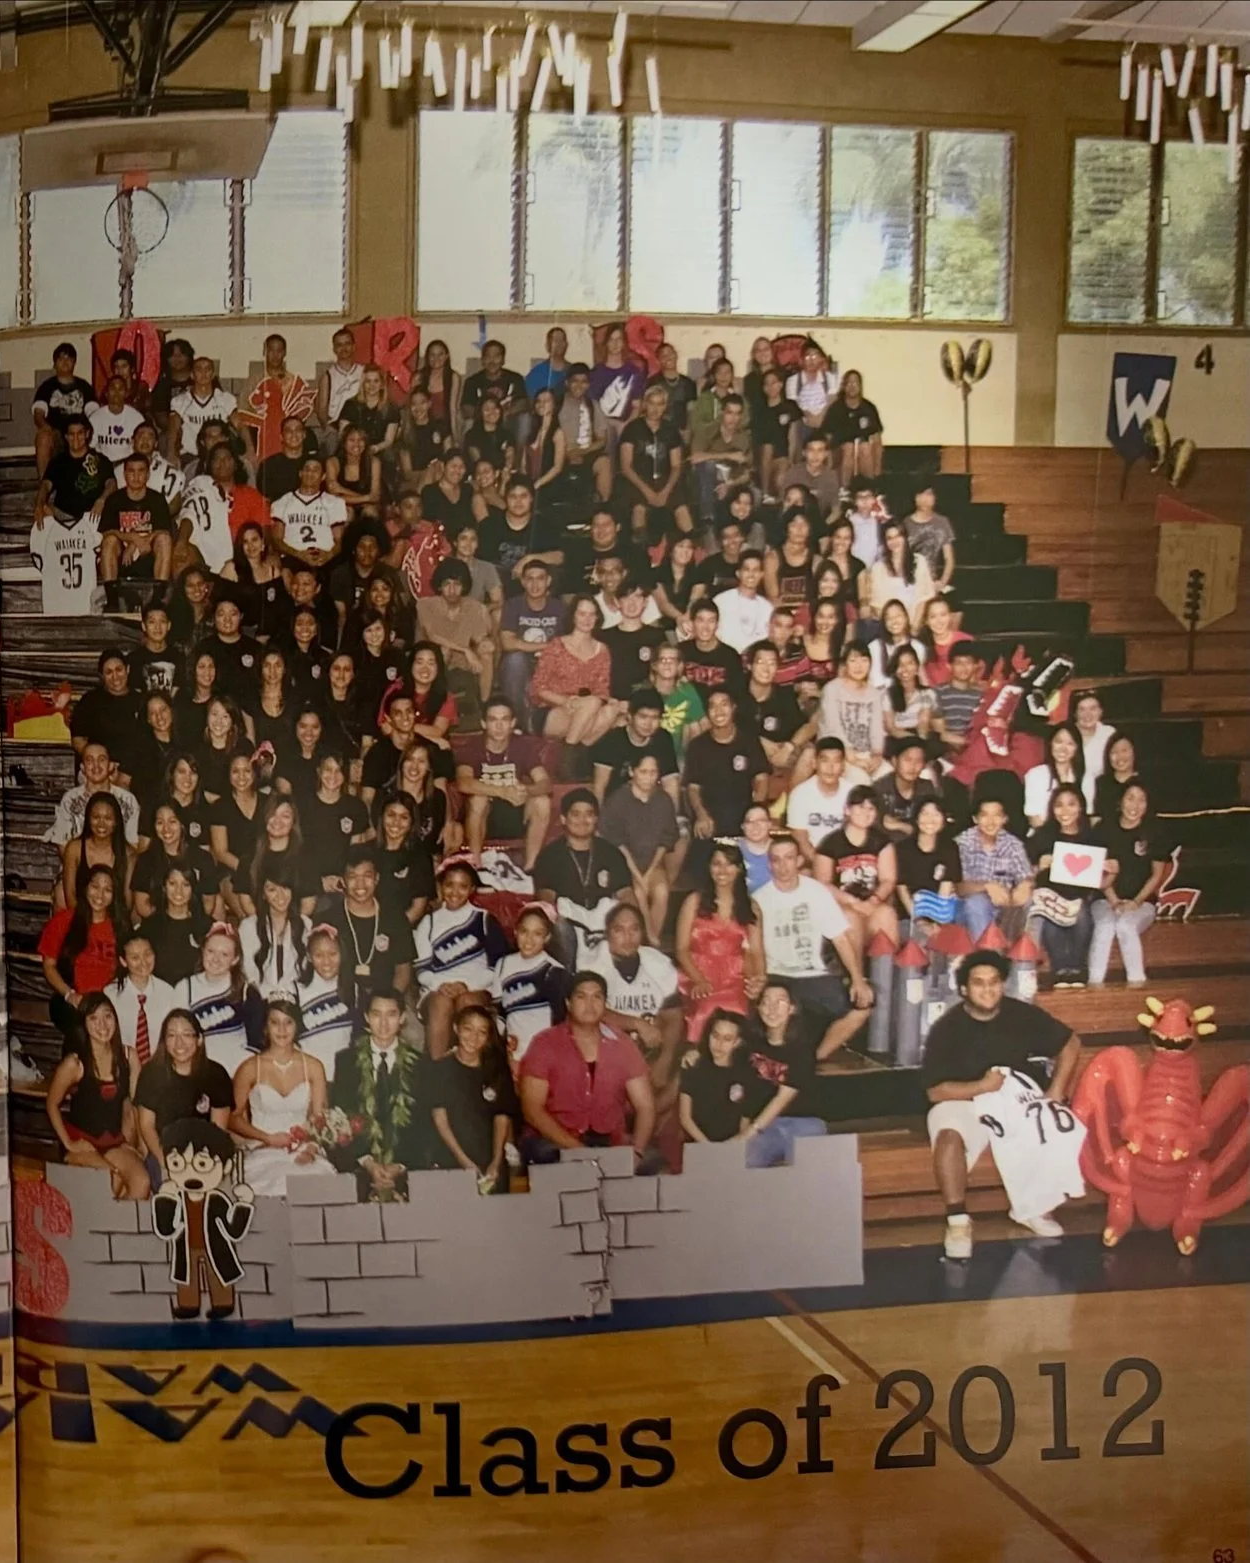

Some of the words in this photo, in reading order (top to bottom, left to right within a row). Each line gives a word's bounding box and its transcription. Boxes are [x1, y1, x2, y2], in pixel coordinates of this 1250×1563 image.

[374, 316, 419, 393] R
[1195, 343, 1215, 375] 4
[1114, 377, 1171, 438] W
[300, 526, 317, 543] 2
[60, 552, 83, 590] 35
[1026, 1099, 1075, 1145] 76
